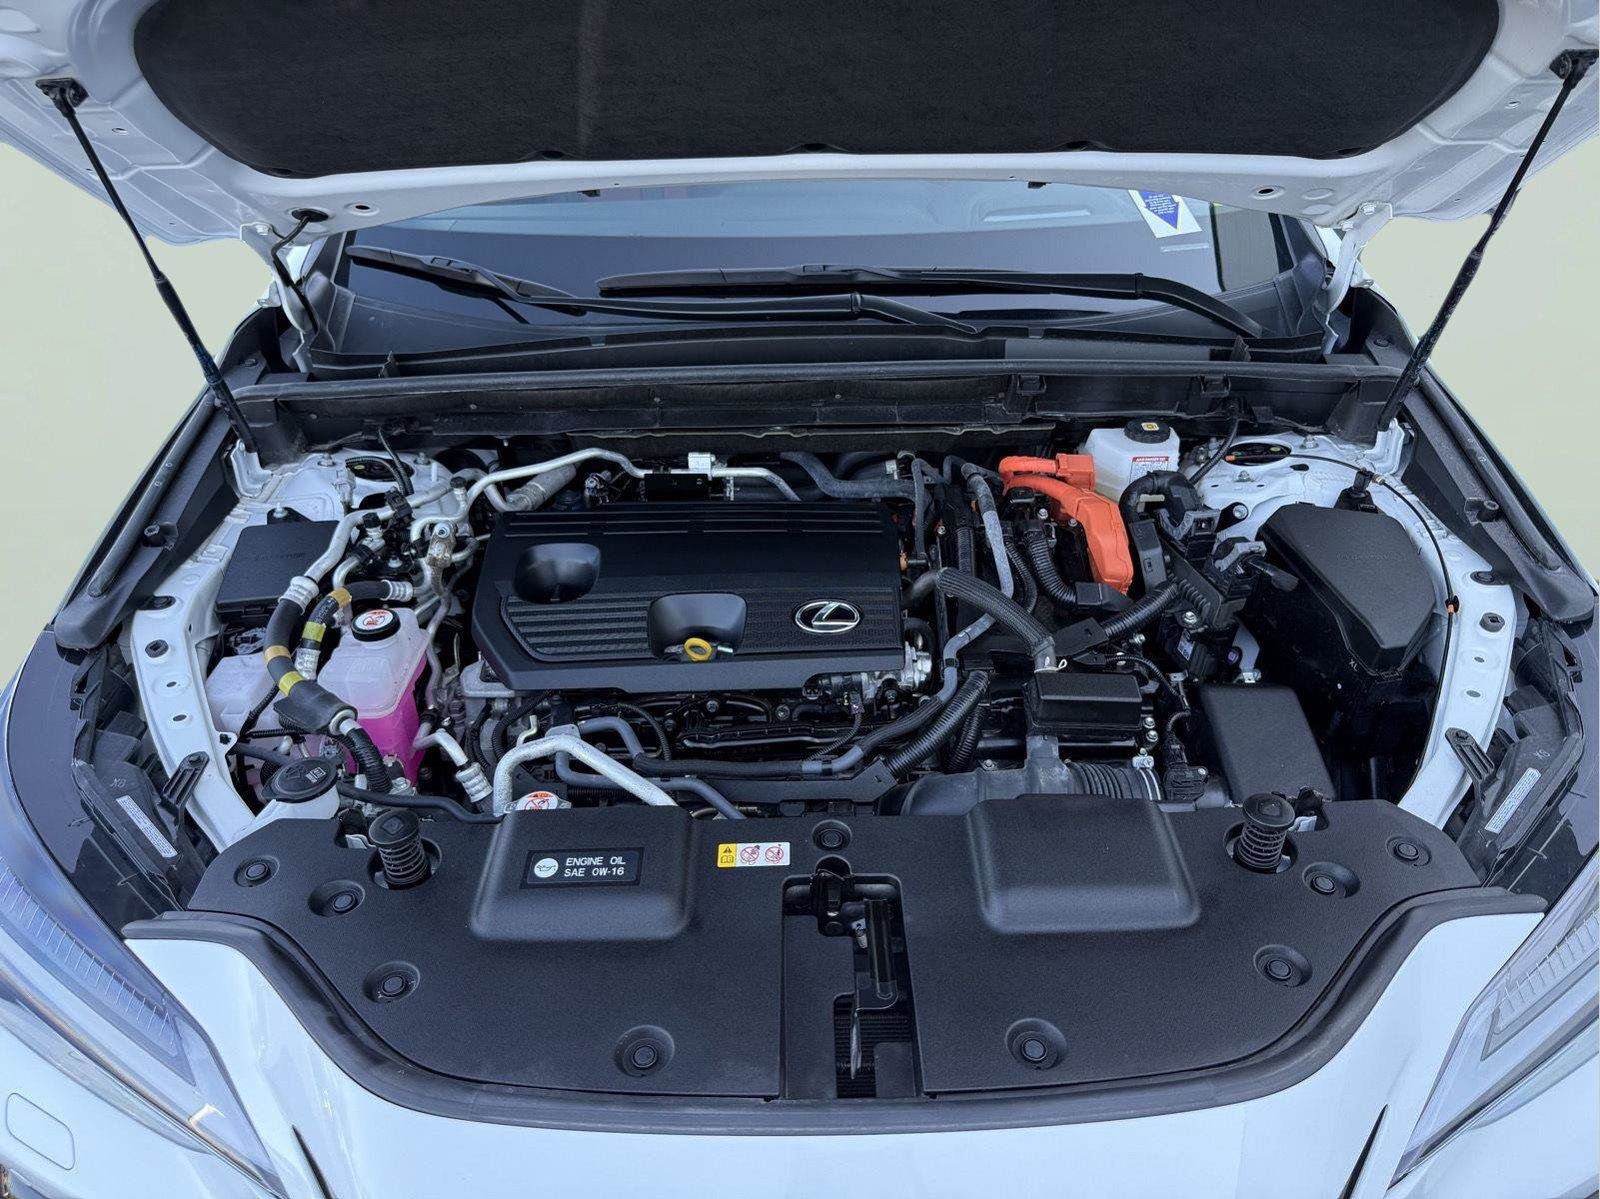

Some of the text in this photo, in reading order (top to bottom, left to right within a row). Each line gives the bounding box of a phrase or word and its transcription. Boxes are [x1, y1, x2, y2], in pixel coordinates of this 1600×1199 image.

[565, 856, 626, 866] ENGINE OIL
[564, 867, 624, 877] SAE 0W-16
